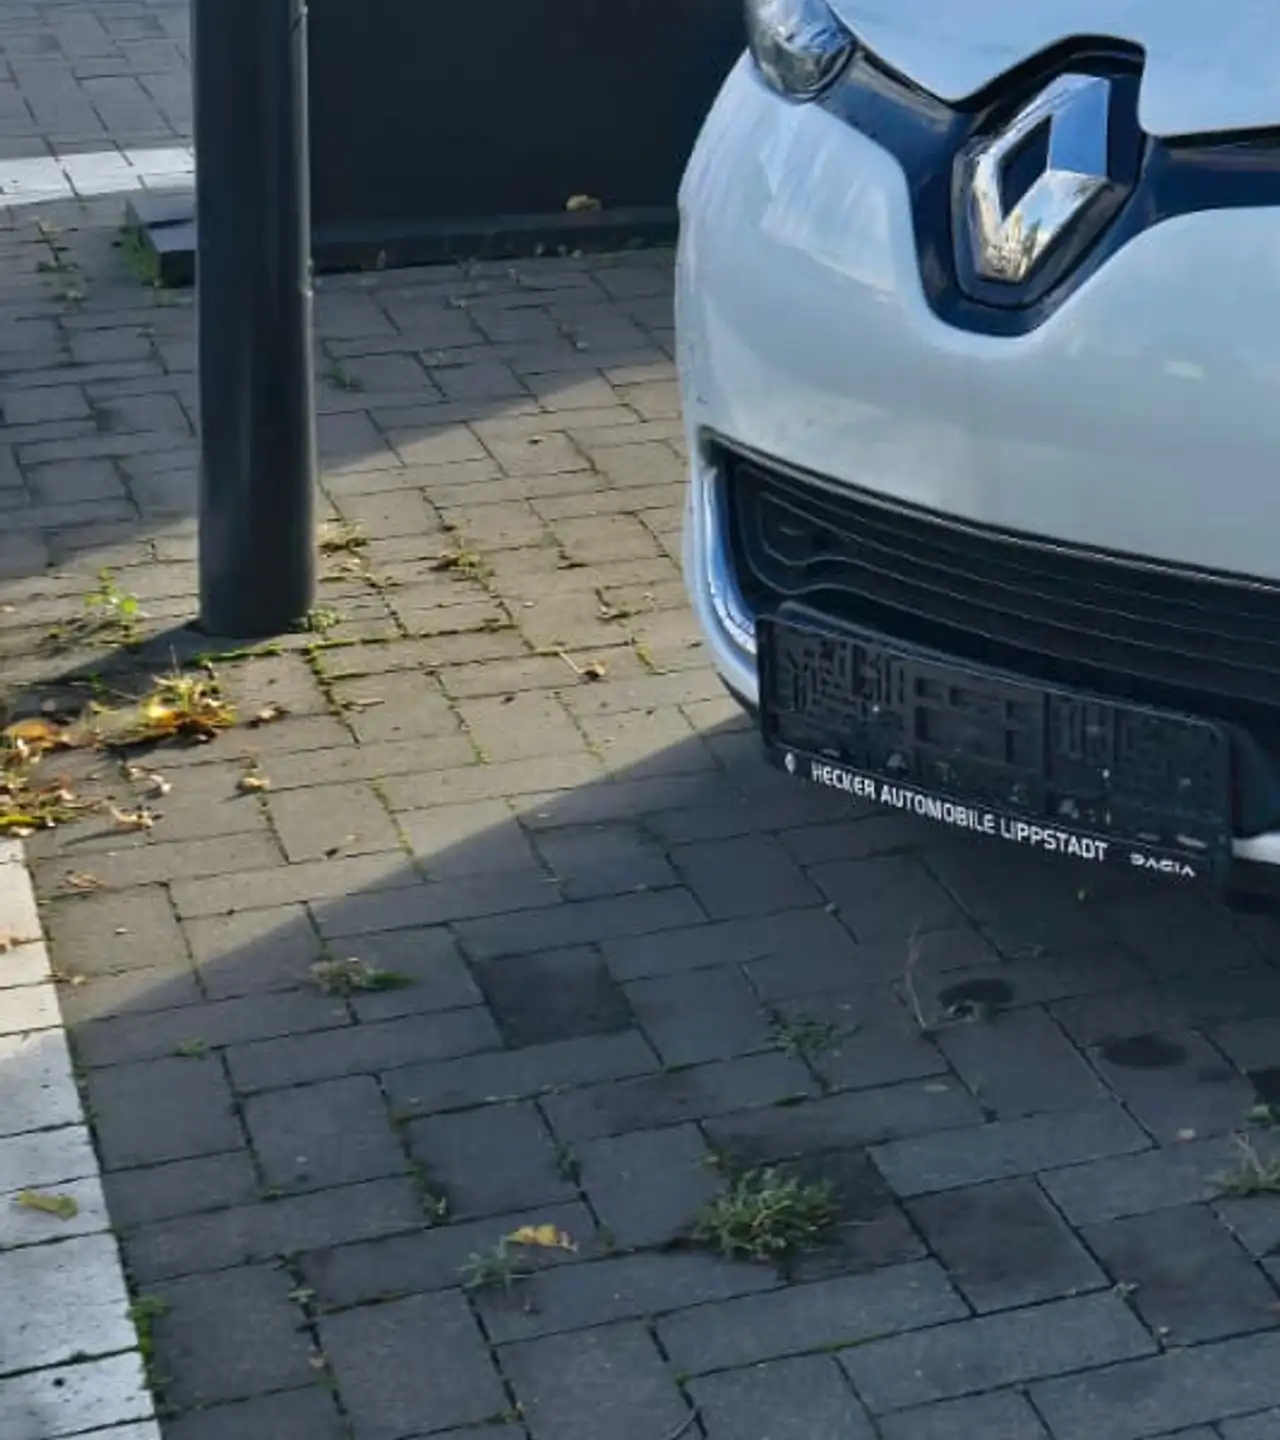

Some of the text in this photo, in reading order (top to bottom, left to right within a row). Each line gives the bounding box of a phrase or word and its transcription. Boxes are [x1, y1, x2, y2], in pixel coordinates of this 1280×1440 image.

[811, 760, 876, 801] HECKER
[880, 785, 996, 835] AUTOMOBILE
[1000, 817, 1109, 863] LIPPSTADT
